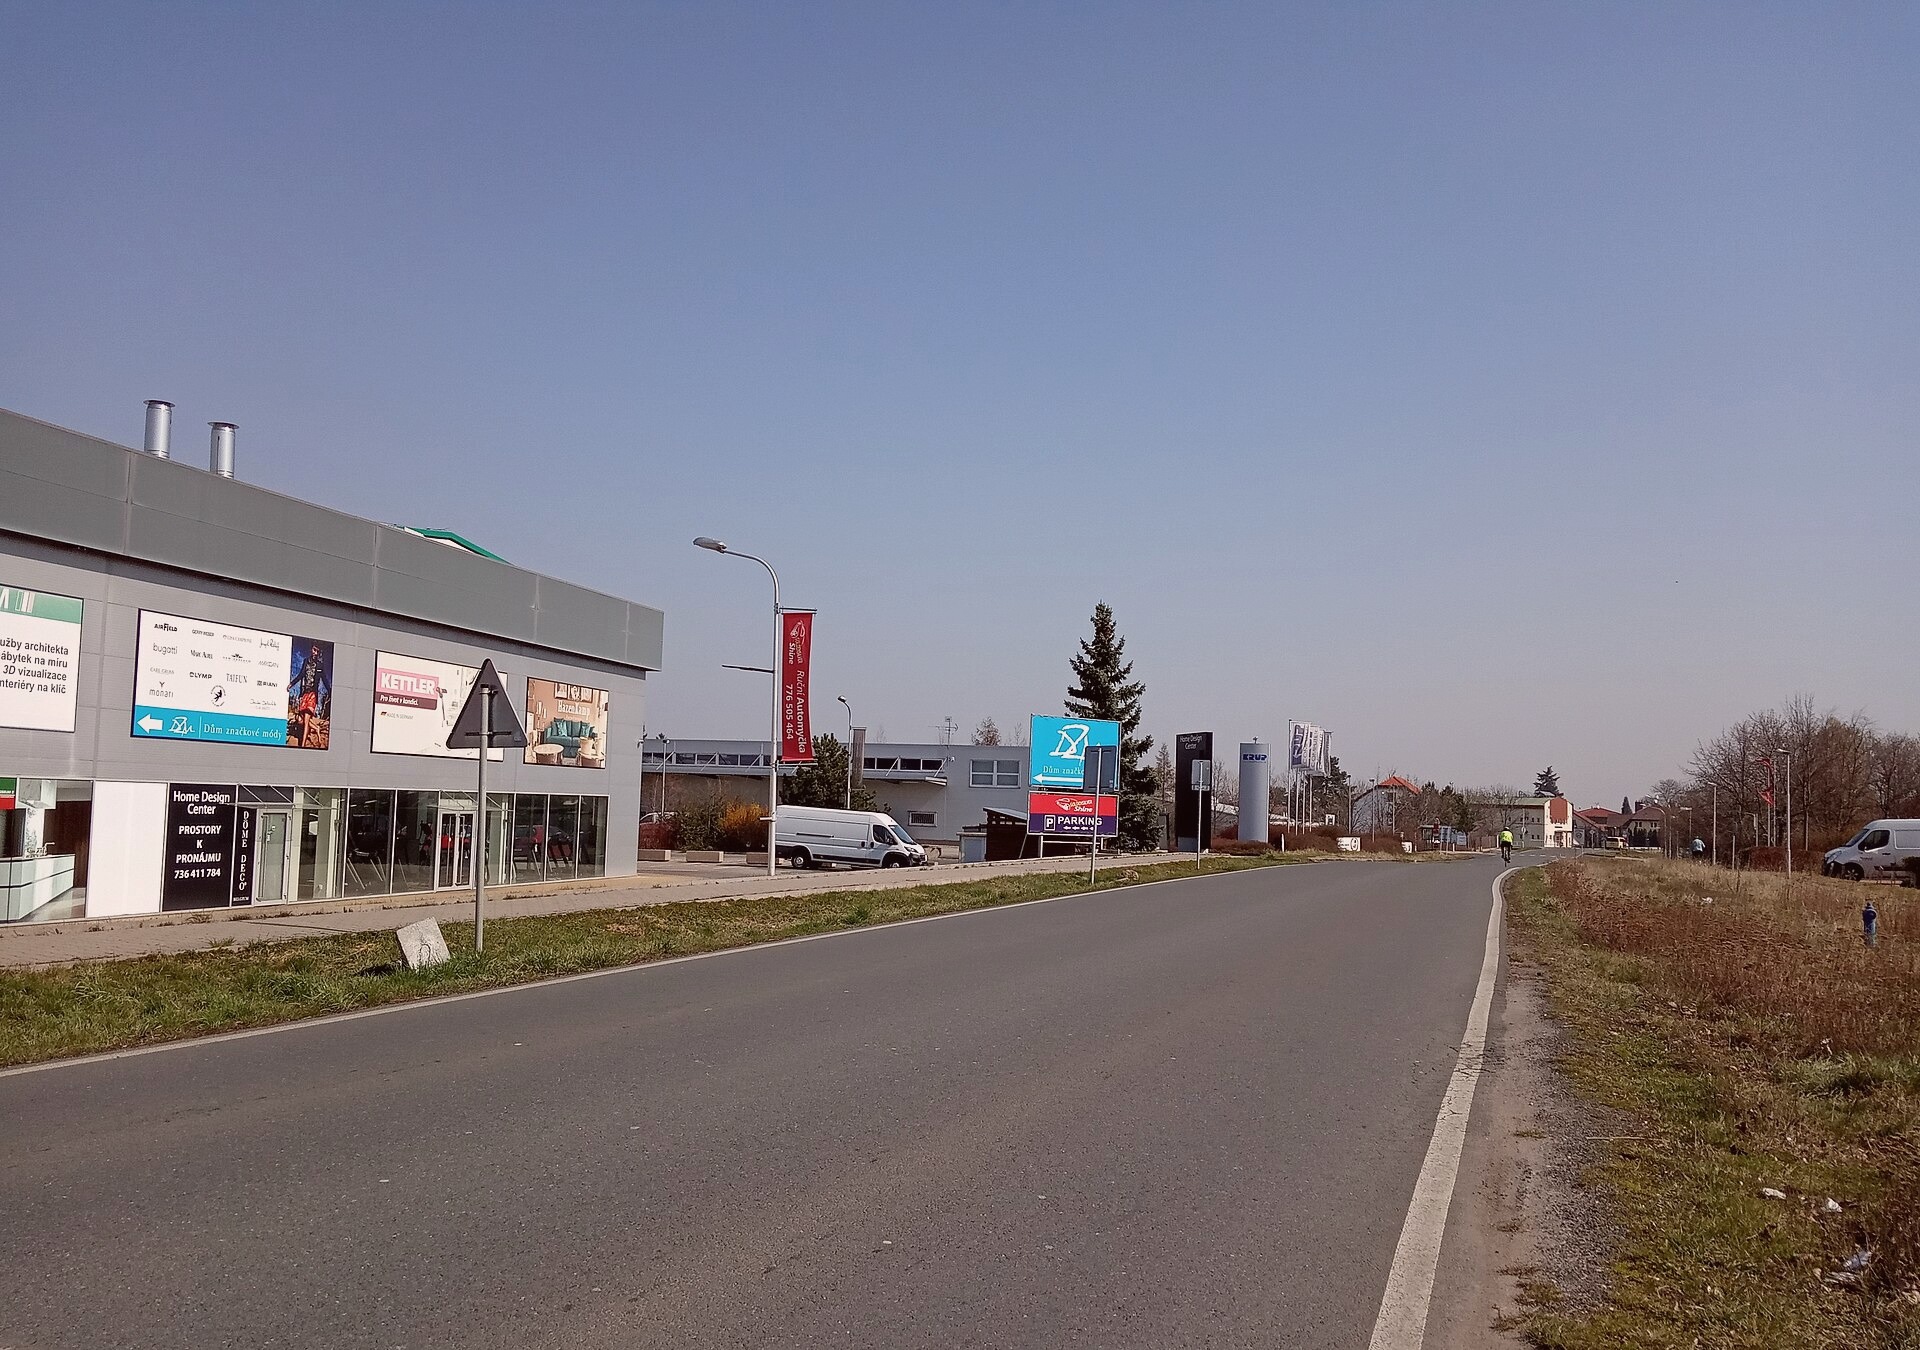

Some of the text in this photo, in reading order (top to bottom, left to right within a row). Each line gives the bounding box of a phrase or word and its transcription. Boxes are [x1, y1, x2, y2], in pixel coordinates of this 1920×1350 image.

[24, 641, 69, 655] architekta
[34, 656, 45, 665] na
[3, 665, 67, 681] 3D vizualizace
[189, 671, 212, 679] OLYMP
[37, 683, 48, 692] na
[381, 672, 435, 695] KETTLER
[797, 670, 805, 695] Ruční
[786, 722, 794, 739] 464
[796, 697, 806, 753] Automyčka
[204, 723, 223, 734] Dům
[226, 726, 259, 737] značkové
[262, 730, 282, 740] módy
[1243, 753, 1267, 761] KRUP
[1043, 765, 1060, 774] Dům
[173, 791, 230, 805] Home Design
[187, 803, 216, 815] Center
[1057, 816, 1103, 826] PARKING
[178, 825, 222, 835] PROSTORY
[196, 839, 203, 849] K
[176, 852, 221, 863] PRONÁJMU
[174, 868, 221, 879] 736 411 784
